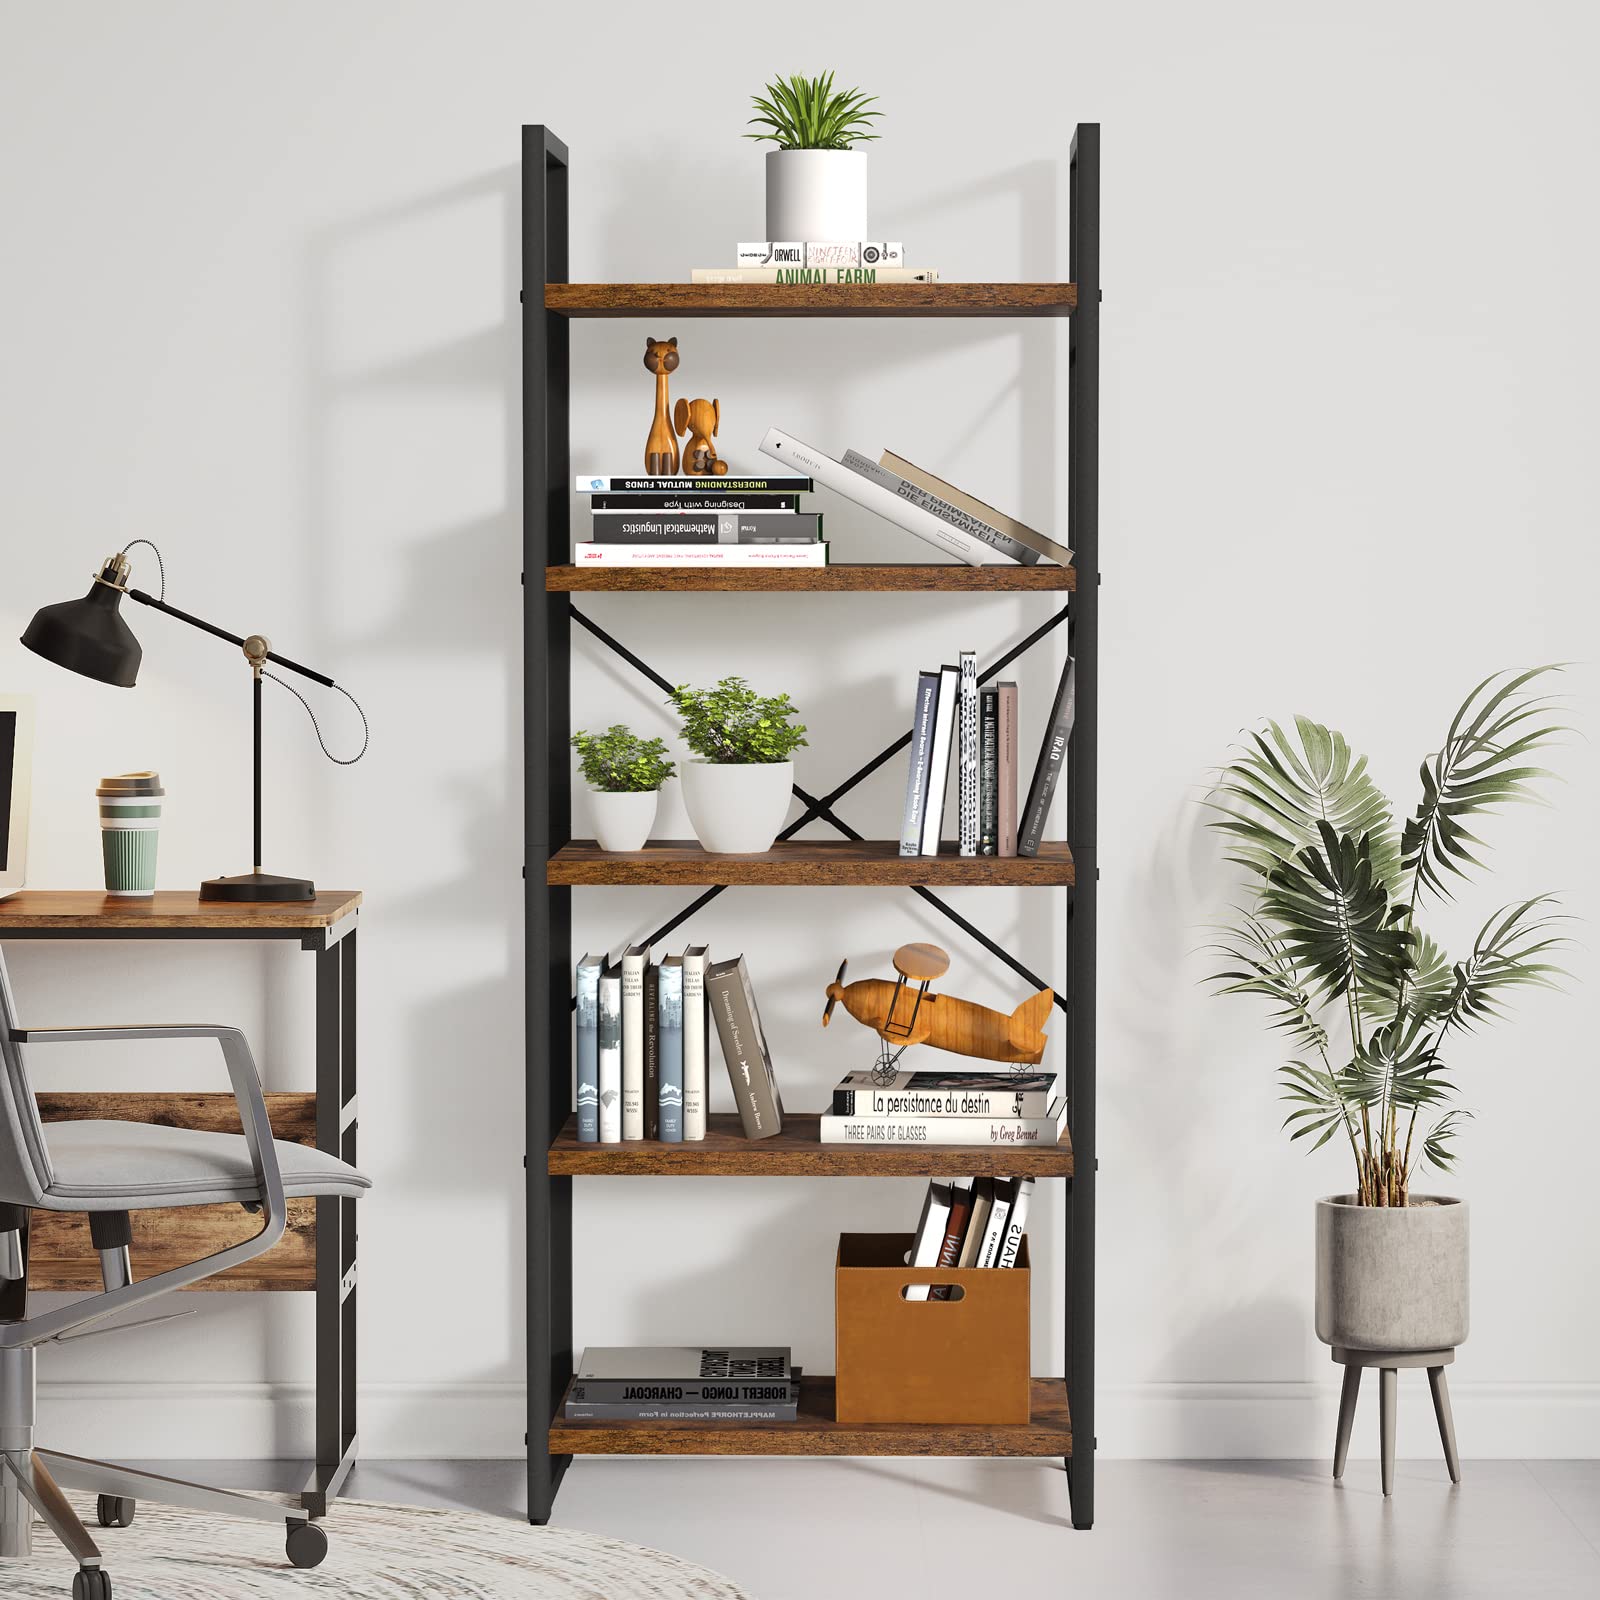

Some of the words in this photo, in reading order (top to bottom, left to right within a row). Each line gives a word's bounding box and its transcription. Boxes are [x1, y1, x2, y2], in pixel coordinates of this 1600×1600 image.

[774, 249, 801, 262] ORWELL
[837, 268, 877, 284] FARM
[625, 481, 655, 489] FUNDS
[657, 481, 693, 489] MUTUAL
[695, 481, 767, 489] UNDERSTANDING
[664, 501, 682, 509] Type
[684, 502, 702, 510] with
[704, 501, 745, 510] Designing
[622, 521, 661, 536] Linguistics
[663, 523, 716, 536] Mathematical
[923, 688, 932, 712] Effective
[920, 714, 929, 736] Internet
[918, 737, 927, 756] Search
[1050, 735, 1065, 760] IRAQ
[1041, 782, 1050, 798] LOGIC
[912, 794, 921, 809] Made
[1040, 797, 1045, 806] OF
[721, 990, 736, 1022] Dreaming
[729, 1022, 738, 1031] of
[732, 1030, 744, 1056] Sweden
[748, 1092, 758, 1112] Andrew
[754, 1112, 763, 1130] Brown
[873, 1090, 884, 1112] La
[886, 1092, 942, 1117] persistance
[945, 1091, 958, 1113] du
[961, 1091, 990, 1113] destin
[844, 1125, 865, 1140] THREE
[866, 1125, 885, 1140] PAIRS
[887, 1125, 896, 1140] OF
[897, 1125, 927, 1141] GLASSES
[990, 1125, 998, 1142] by
[999, 1125, 1015, 1142] Greg
[1016, 1125, 1038, 1140] Bennet
